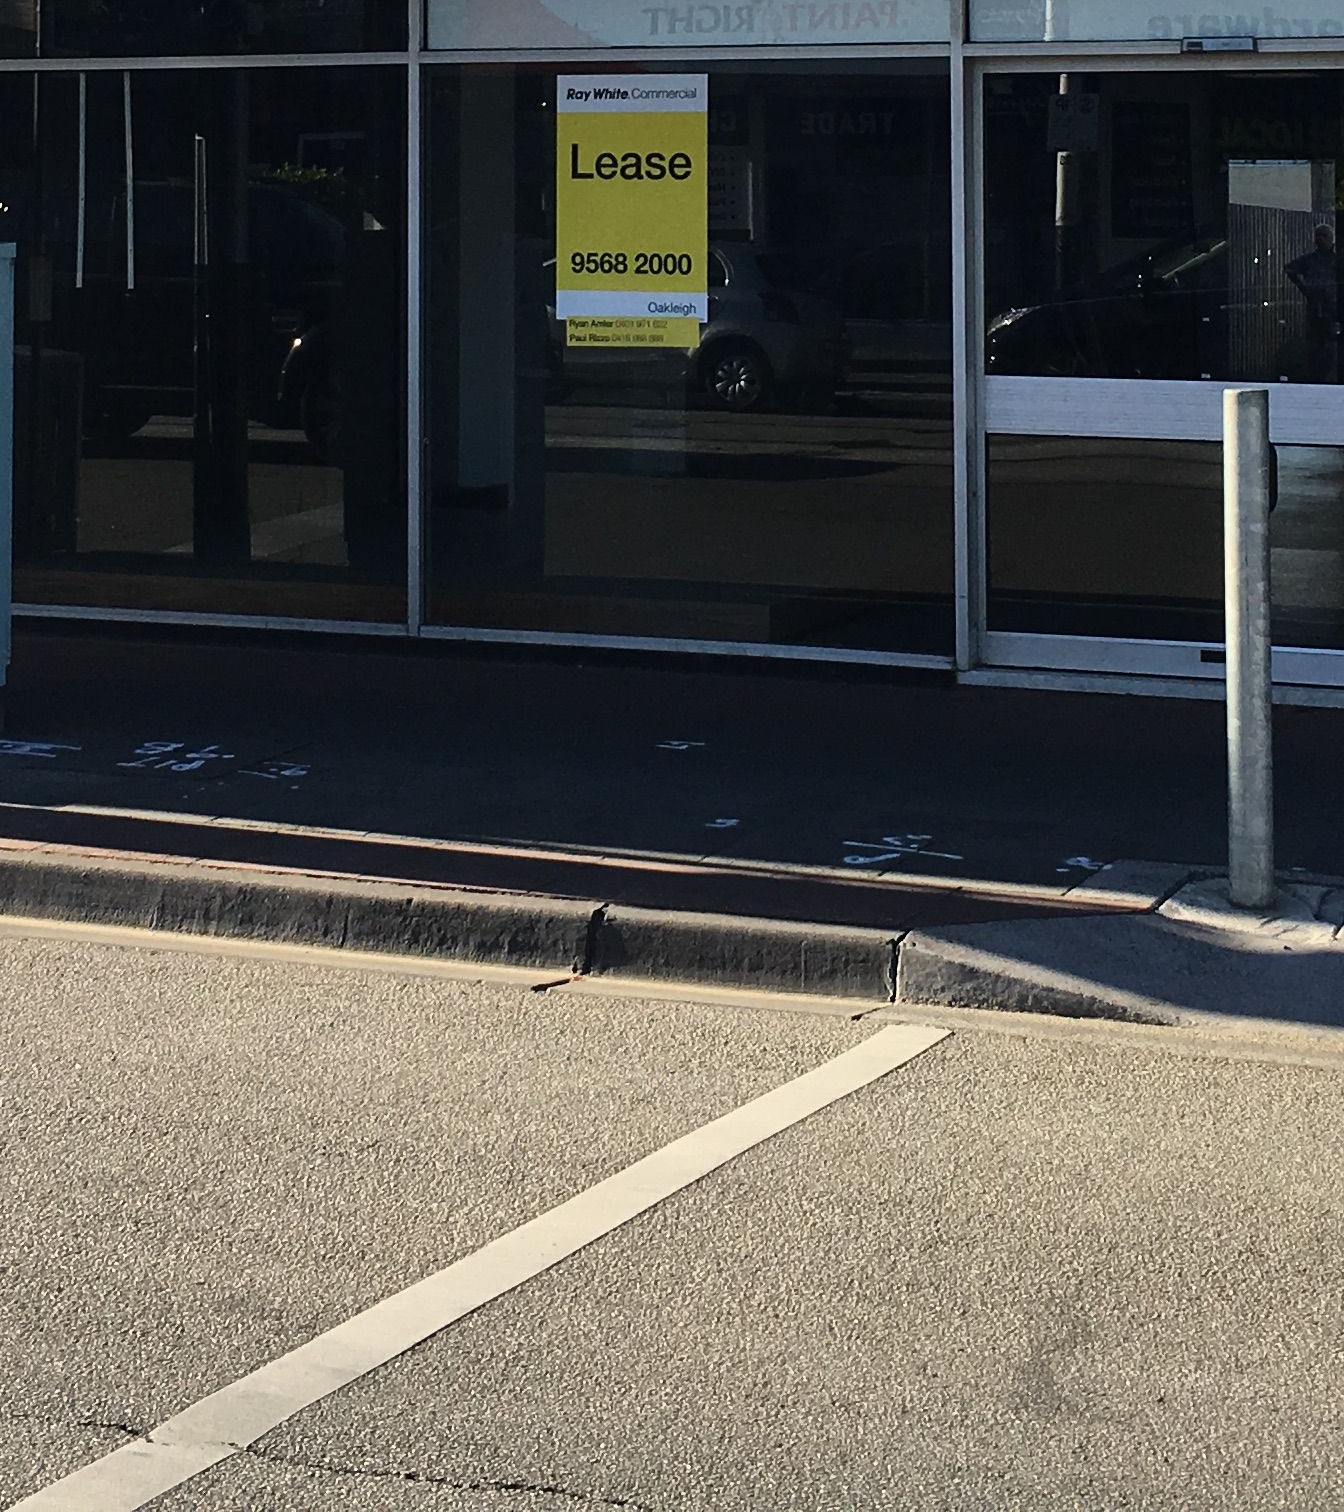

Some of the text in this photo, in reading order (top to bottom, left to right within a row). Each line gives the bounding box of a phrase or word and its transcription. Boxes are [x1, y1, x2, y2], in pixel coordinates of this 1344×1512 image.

[566, 88, 592, 101] Ray
[631, 88, 697, 100] Commercial
[570, 143, 692, 180] Lease
[570, 252, 692, 275] 9568 2000
[647, 301, 697, 315] Oakleigh
